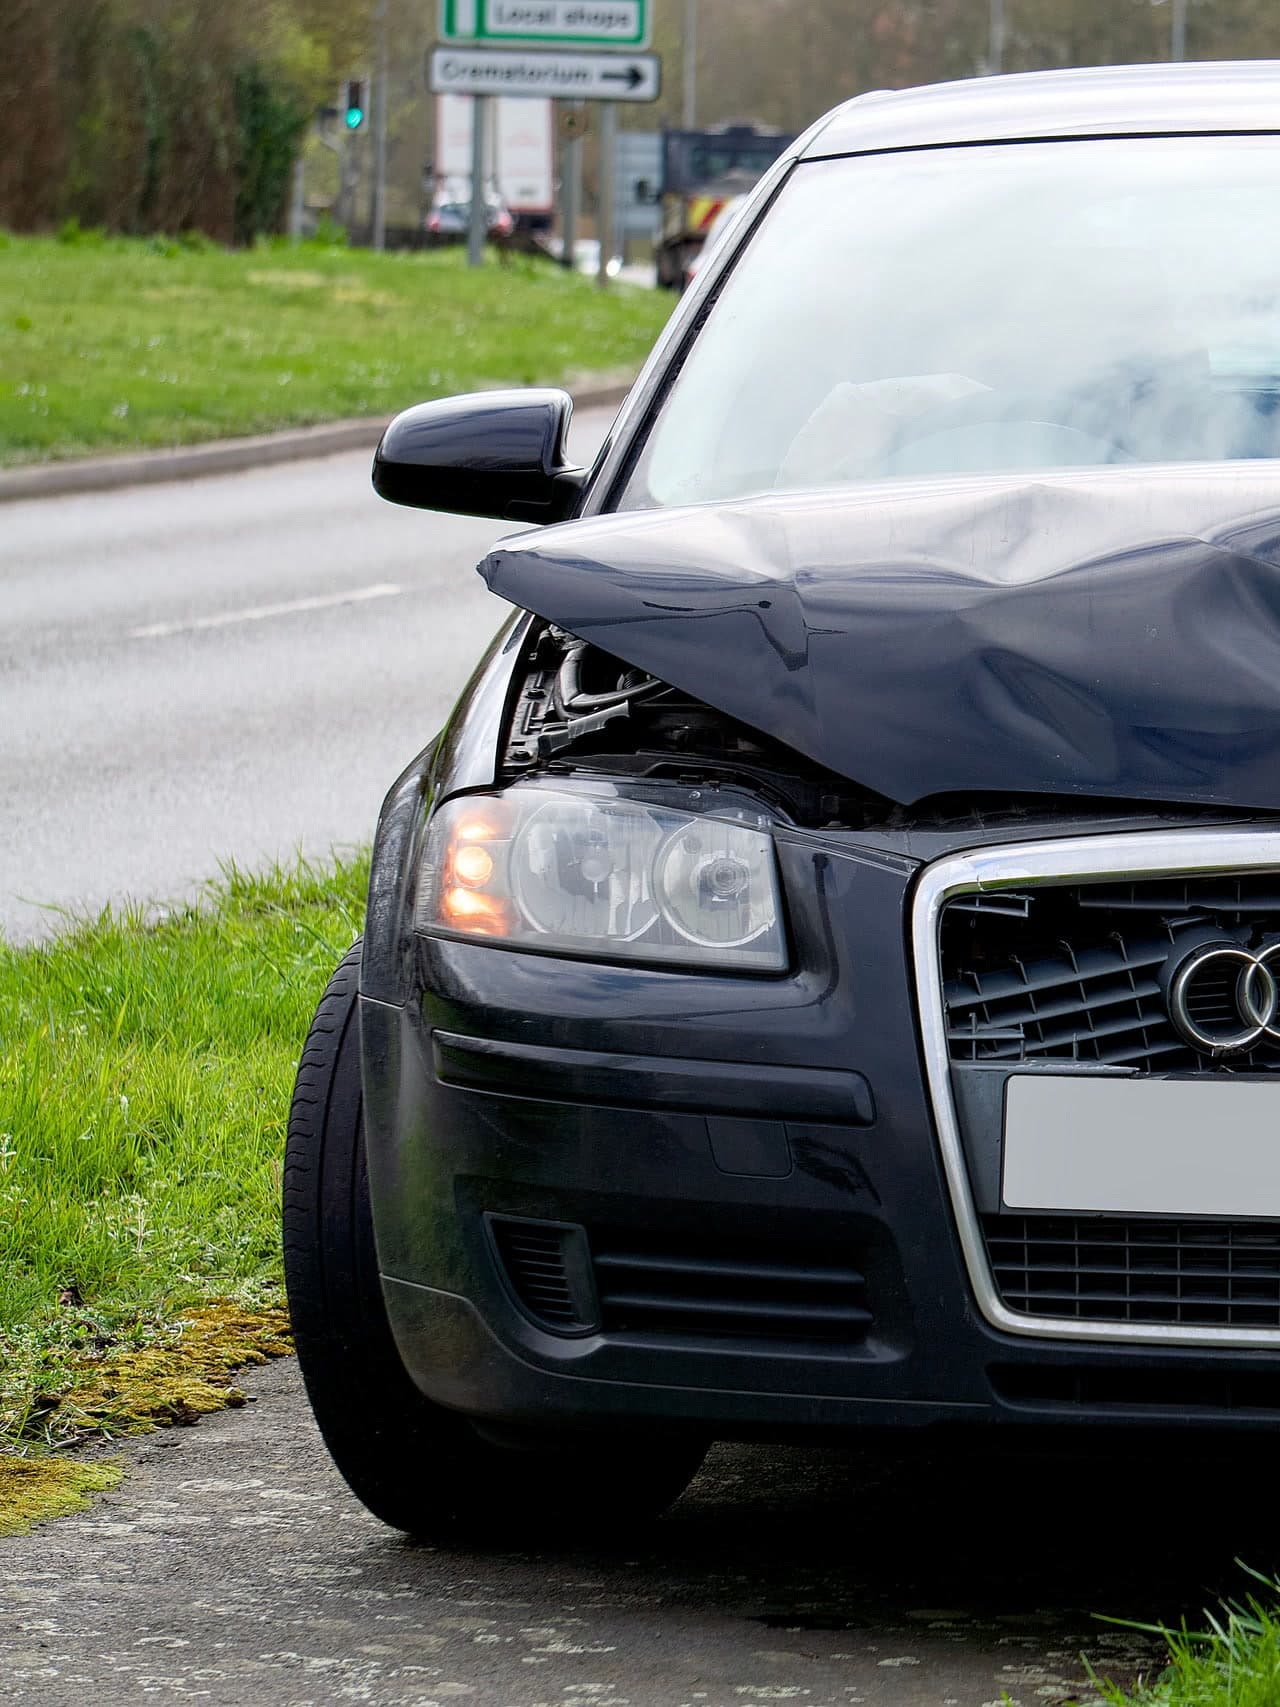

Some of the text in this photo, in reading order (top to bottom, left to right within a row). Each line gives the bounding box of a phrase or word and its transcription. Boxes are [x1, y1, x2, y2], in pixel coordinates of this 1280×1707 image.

[496, 6, 630, 29] Local shops
[441, 60, 594, 83] Crematorium
